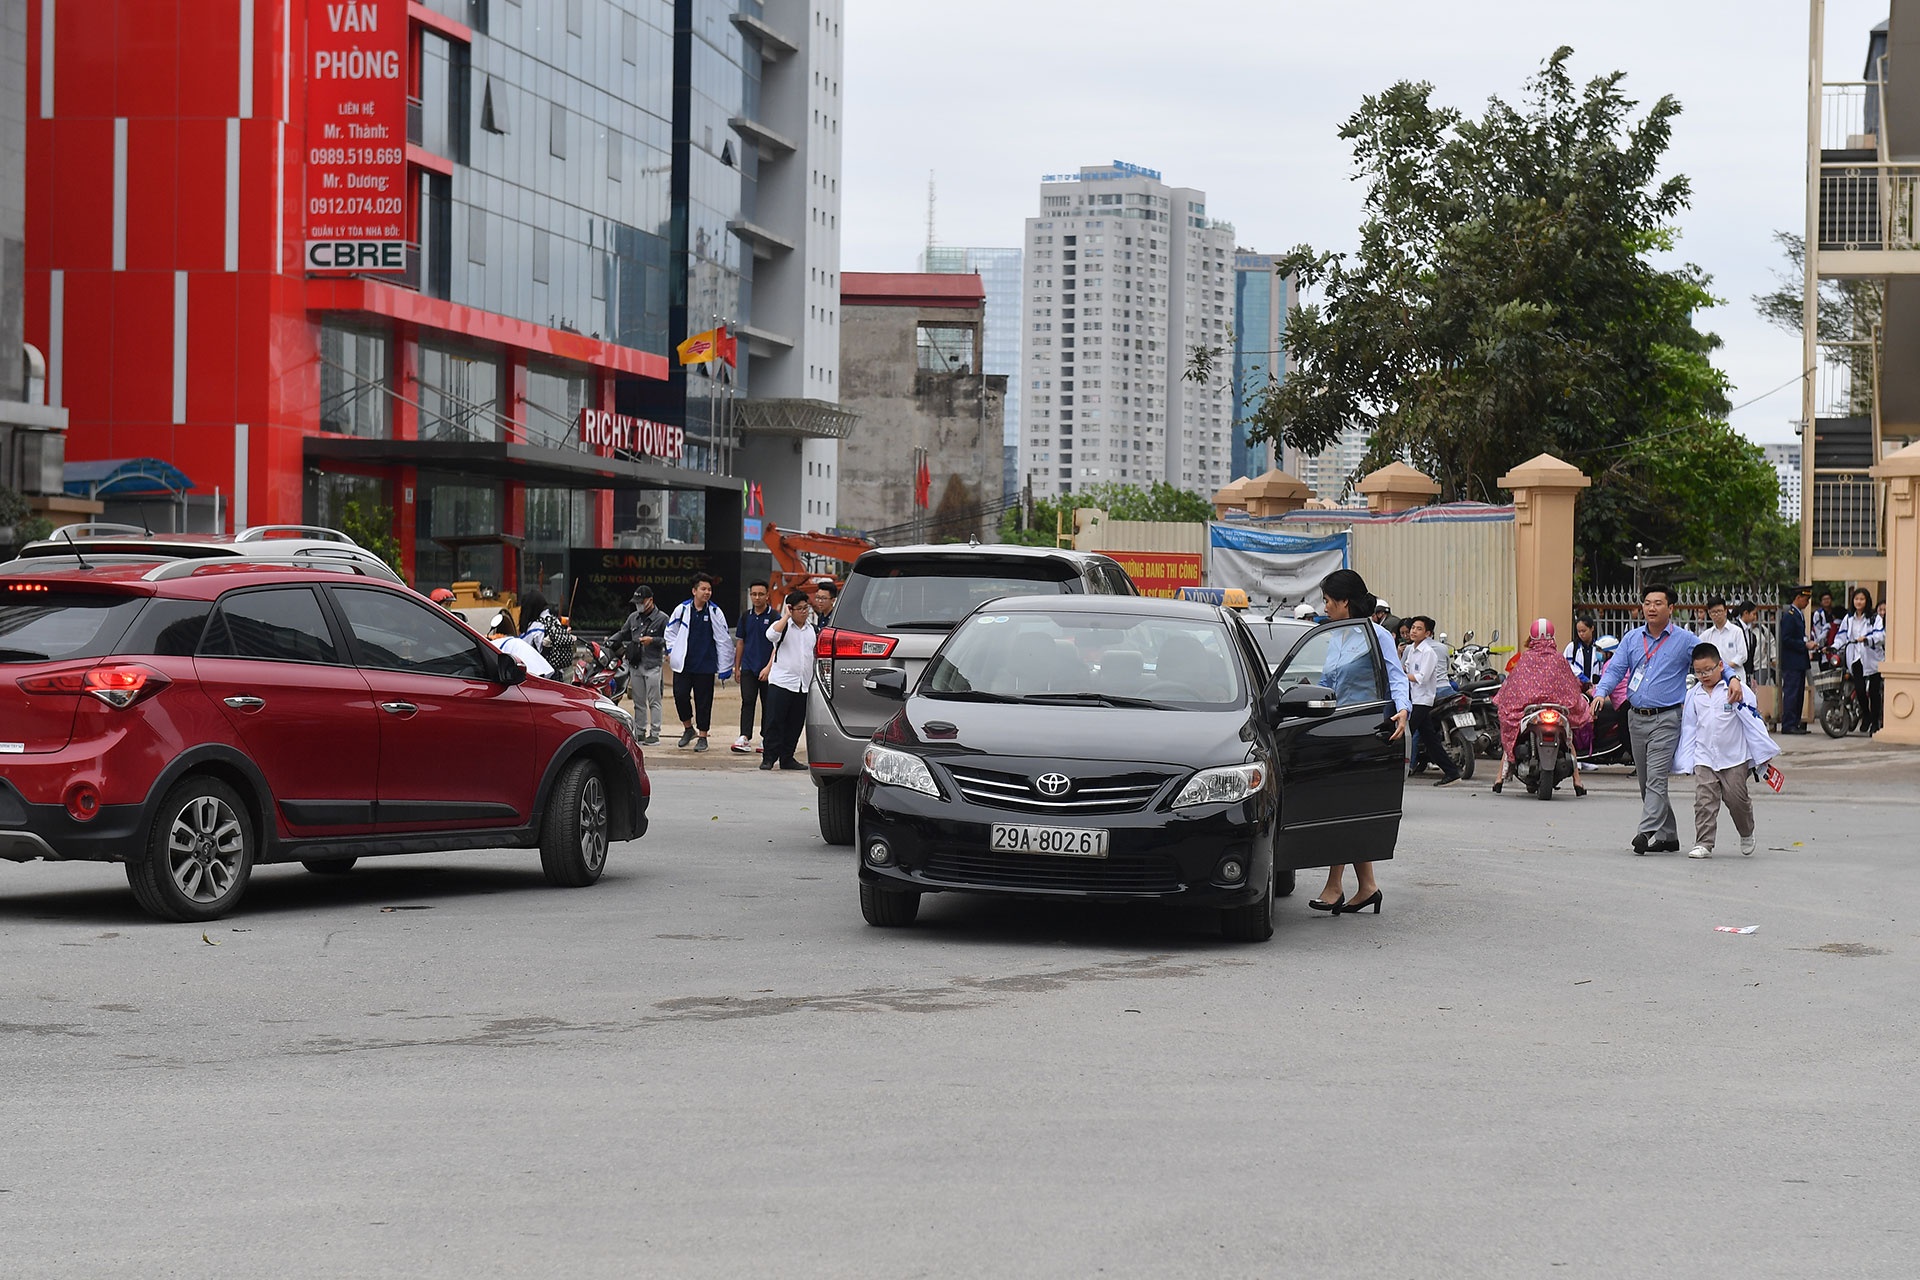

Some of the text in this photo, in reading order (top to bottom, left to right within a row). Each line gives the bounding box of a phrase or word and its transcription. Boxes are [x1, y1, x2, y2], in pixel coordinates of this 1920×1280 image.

[327, 0, 378, 33] VĂN
[315, 45, 399, 79] PHÒNG
[338, 101, 375, 117] LIÊN HỆ
[324, 124, 389, 139] Mr. Thành:
[310, 148, 402, 165] 0989.519.669
[323, 173, 389, 192] Mr. Dương:
[310, 197, 402, 215] 0912.074.020
[310, 242, 402, 267] CBRE
[585, 409, 684, 459] RICHY TOWER
[602, 555, 708, 569] SUNHOUSE
[1146, 562, 1164, 578] ĐANG
[1167, 562, 1178, 578] THI
[1180, 560, 1198, 579] CÔNG
[1220, 593, 1245, 606] TAXI
[995, 827, 1102, 853] 29A-802.61
